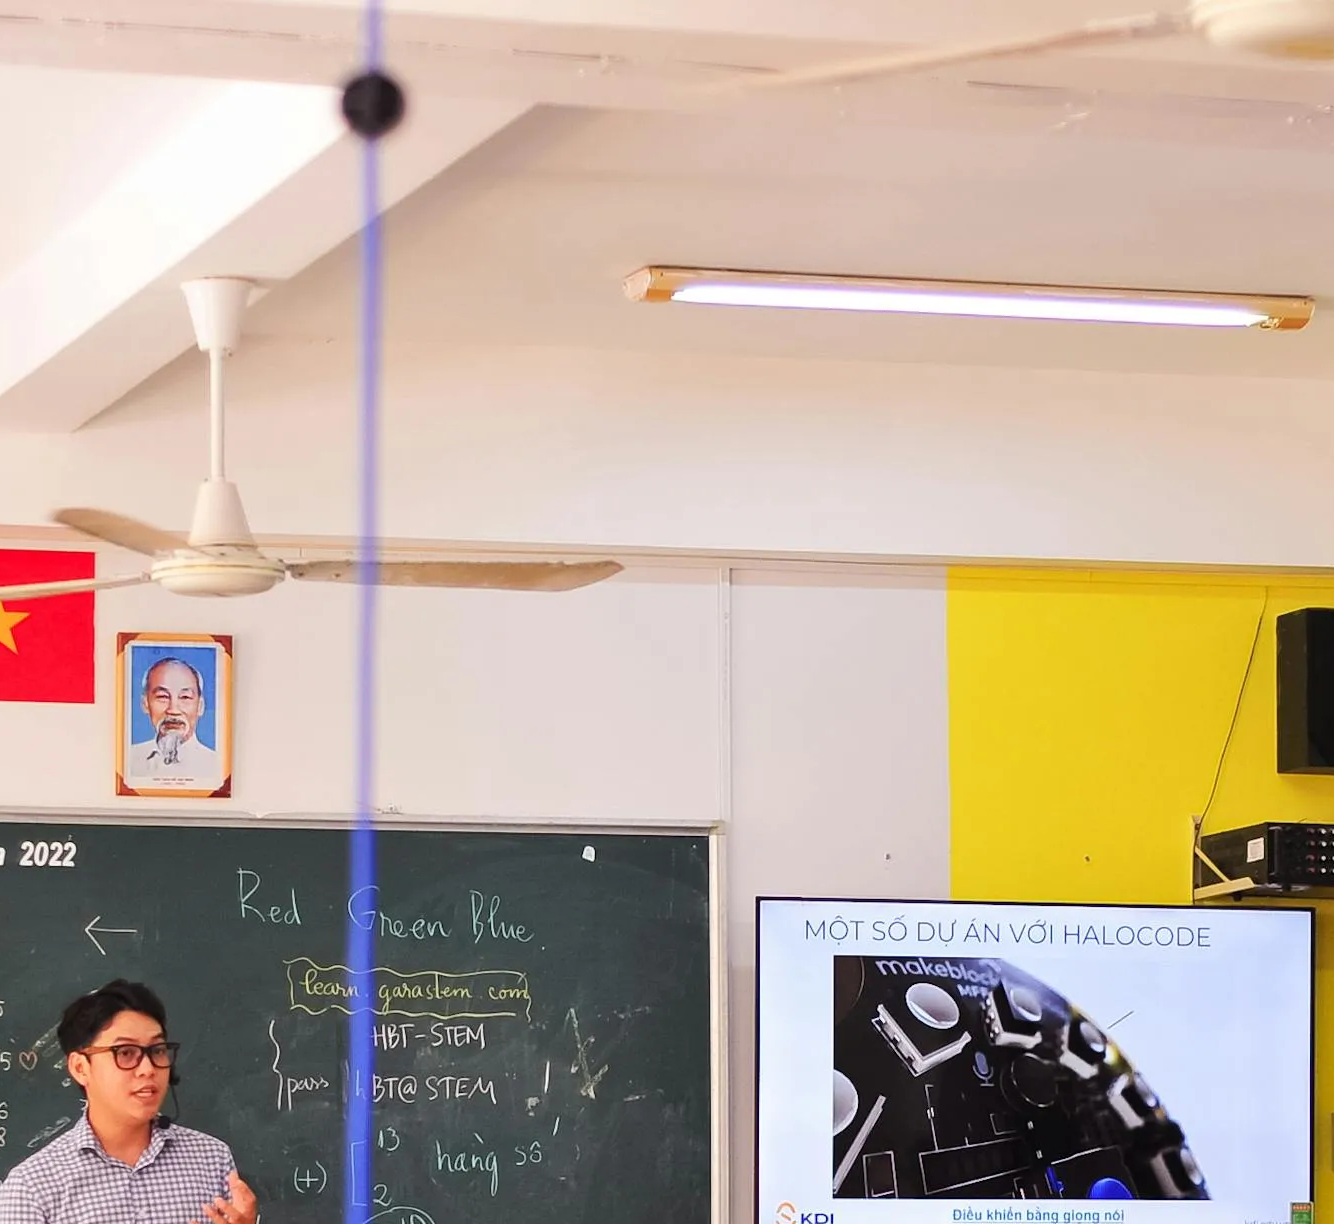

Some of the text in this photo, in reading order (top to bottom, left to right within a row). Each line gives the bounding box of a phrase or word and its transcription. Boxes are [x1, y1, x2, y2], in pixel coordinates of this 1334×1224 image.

[19, 840, 78, 868] 2022
[236, 867, 535, 945] Red Green Blue
[805, 914, 1212, 948] MỘT SỐ DỰ ÁN VỚI HALOCODE
[286, 1075, 330, 1112] pass
[377, 1126, 401, 1152] 13
[435, 1131, 499, 1197] hàng
[371, 1183, 393, 1207] 2
[952, 1205, 983, 1222] Điều
[1025, 1206, 1059, 1224] bằng
